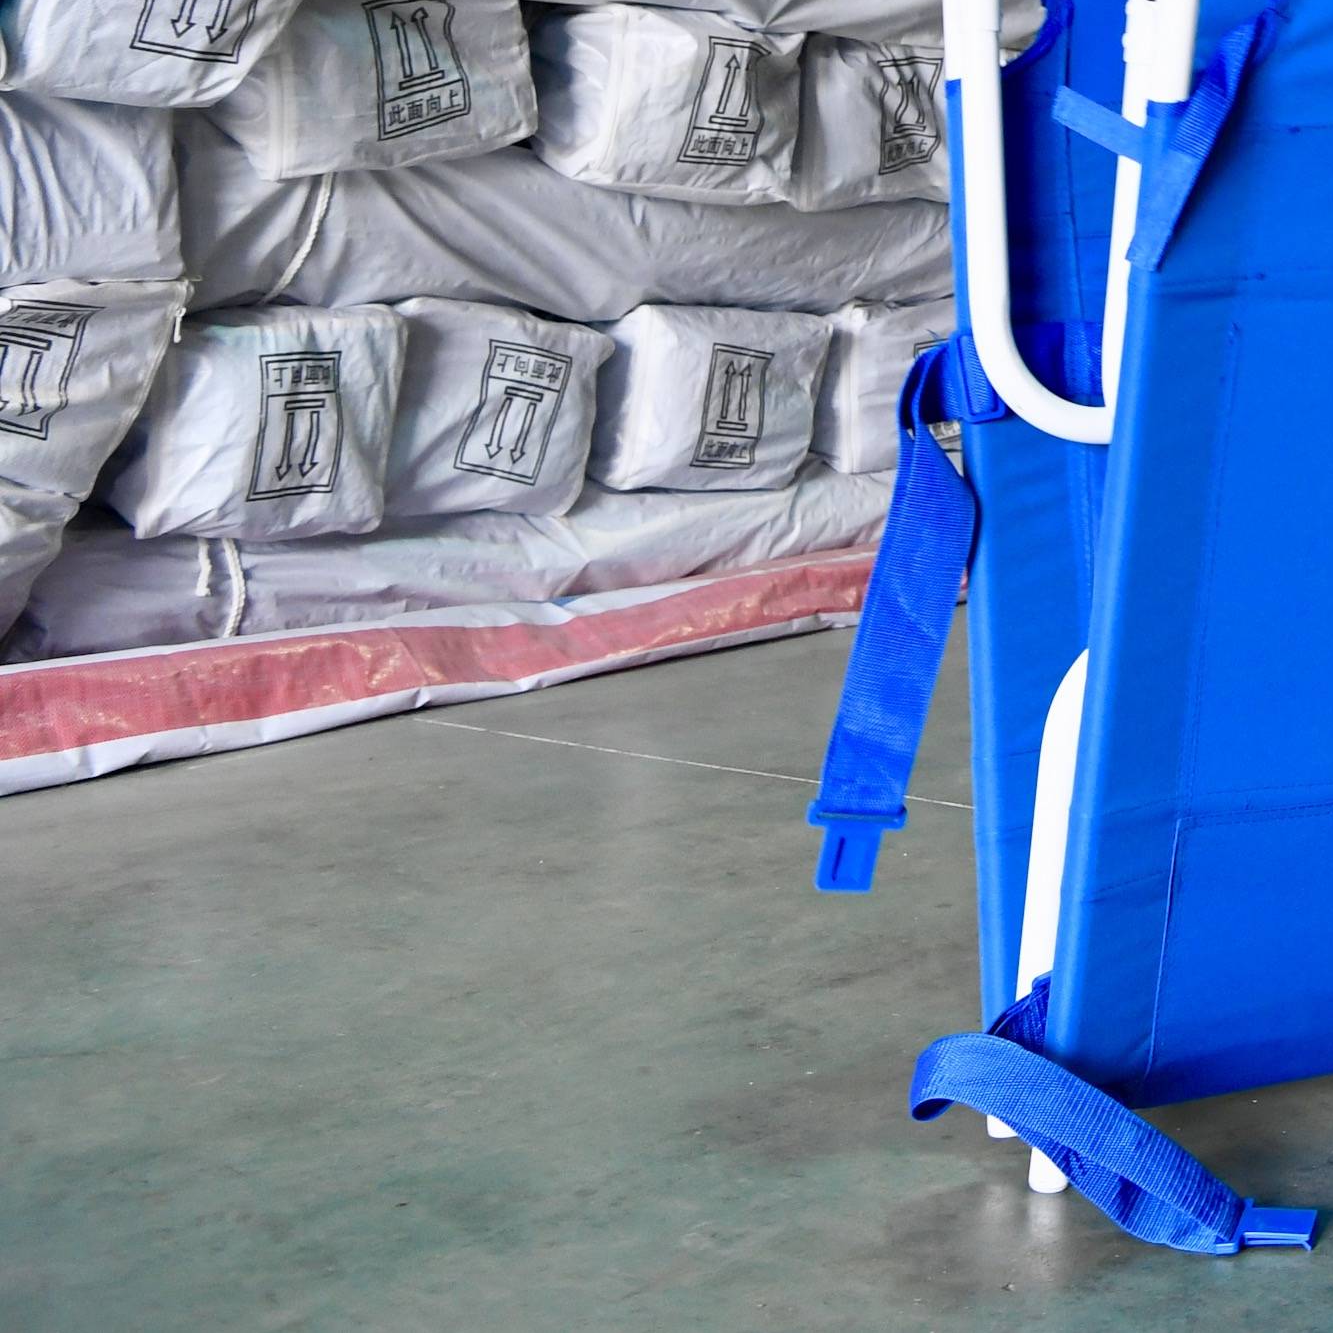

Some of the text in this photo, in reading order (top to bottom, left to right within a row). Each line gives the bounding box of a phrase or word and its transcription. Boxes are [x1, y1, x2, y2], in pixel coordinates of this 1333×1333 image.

[388, 91, 459, 127] 此面向上
[692, 134, 747, 158] 此面向上
[273, 364, 332, 387] 此面向上
[497, 353, 562, 381] 此面向上
[702, 439, 749, 460] 此面向上
